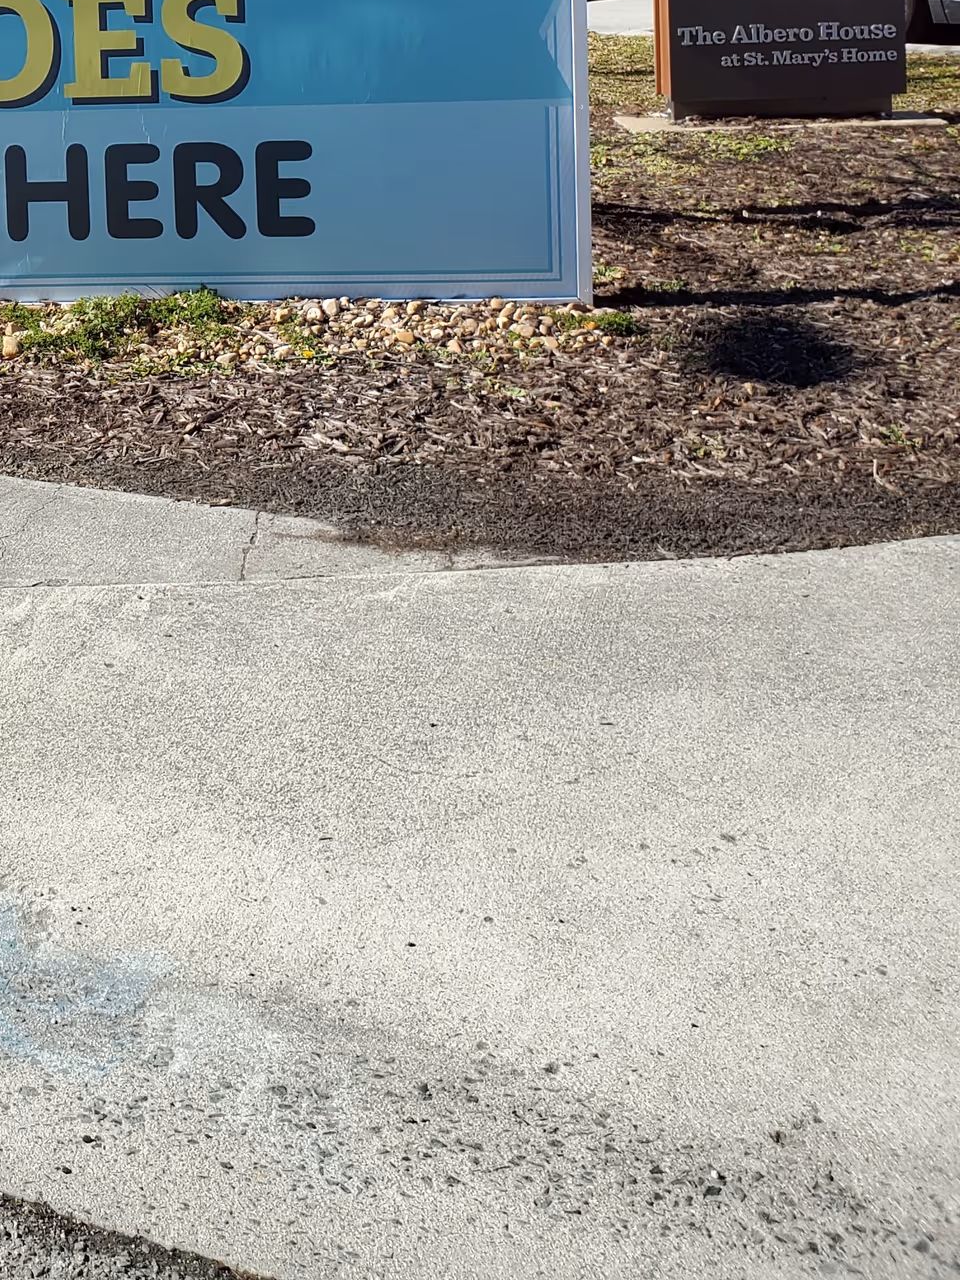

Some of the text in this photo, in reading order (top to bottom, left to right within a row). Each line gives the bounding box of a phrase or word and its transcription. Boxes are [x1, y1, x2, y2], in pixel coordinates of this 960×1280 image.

[678, 21, 897, 46] The Albero House
[721, 47, 898, 67] at St. Mary's Home
[4, 140, 316, 242] HERE
